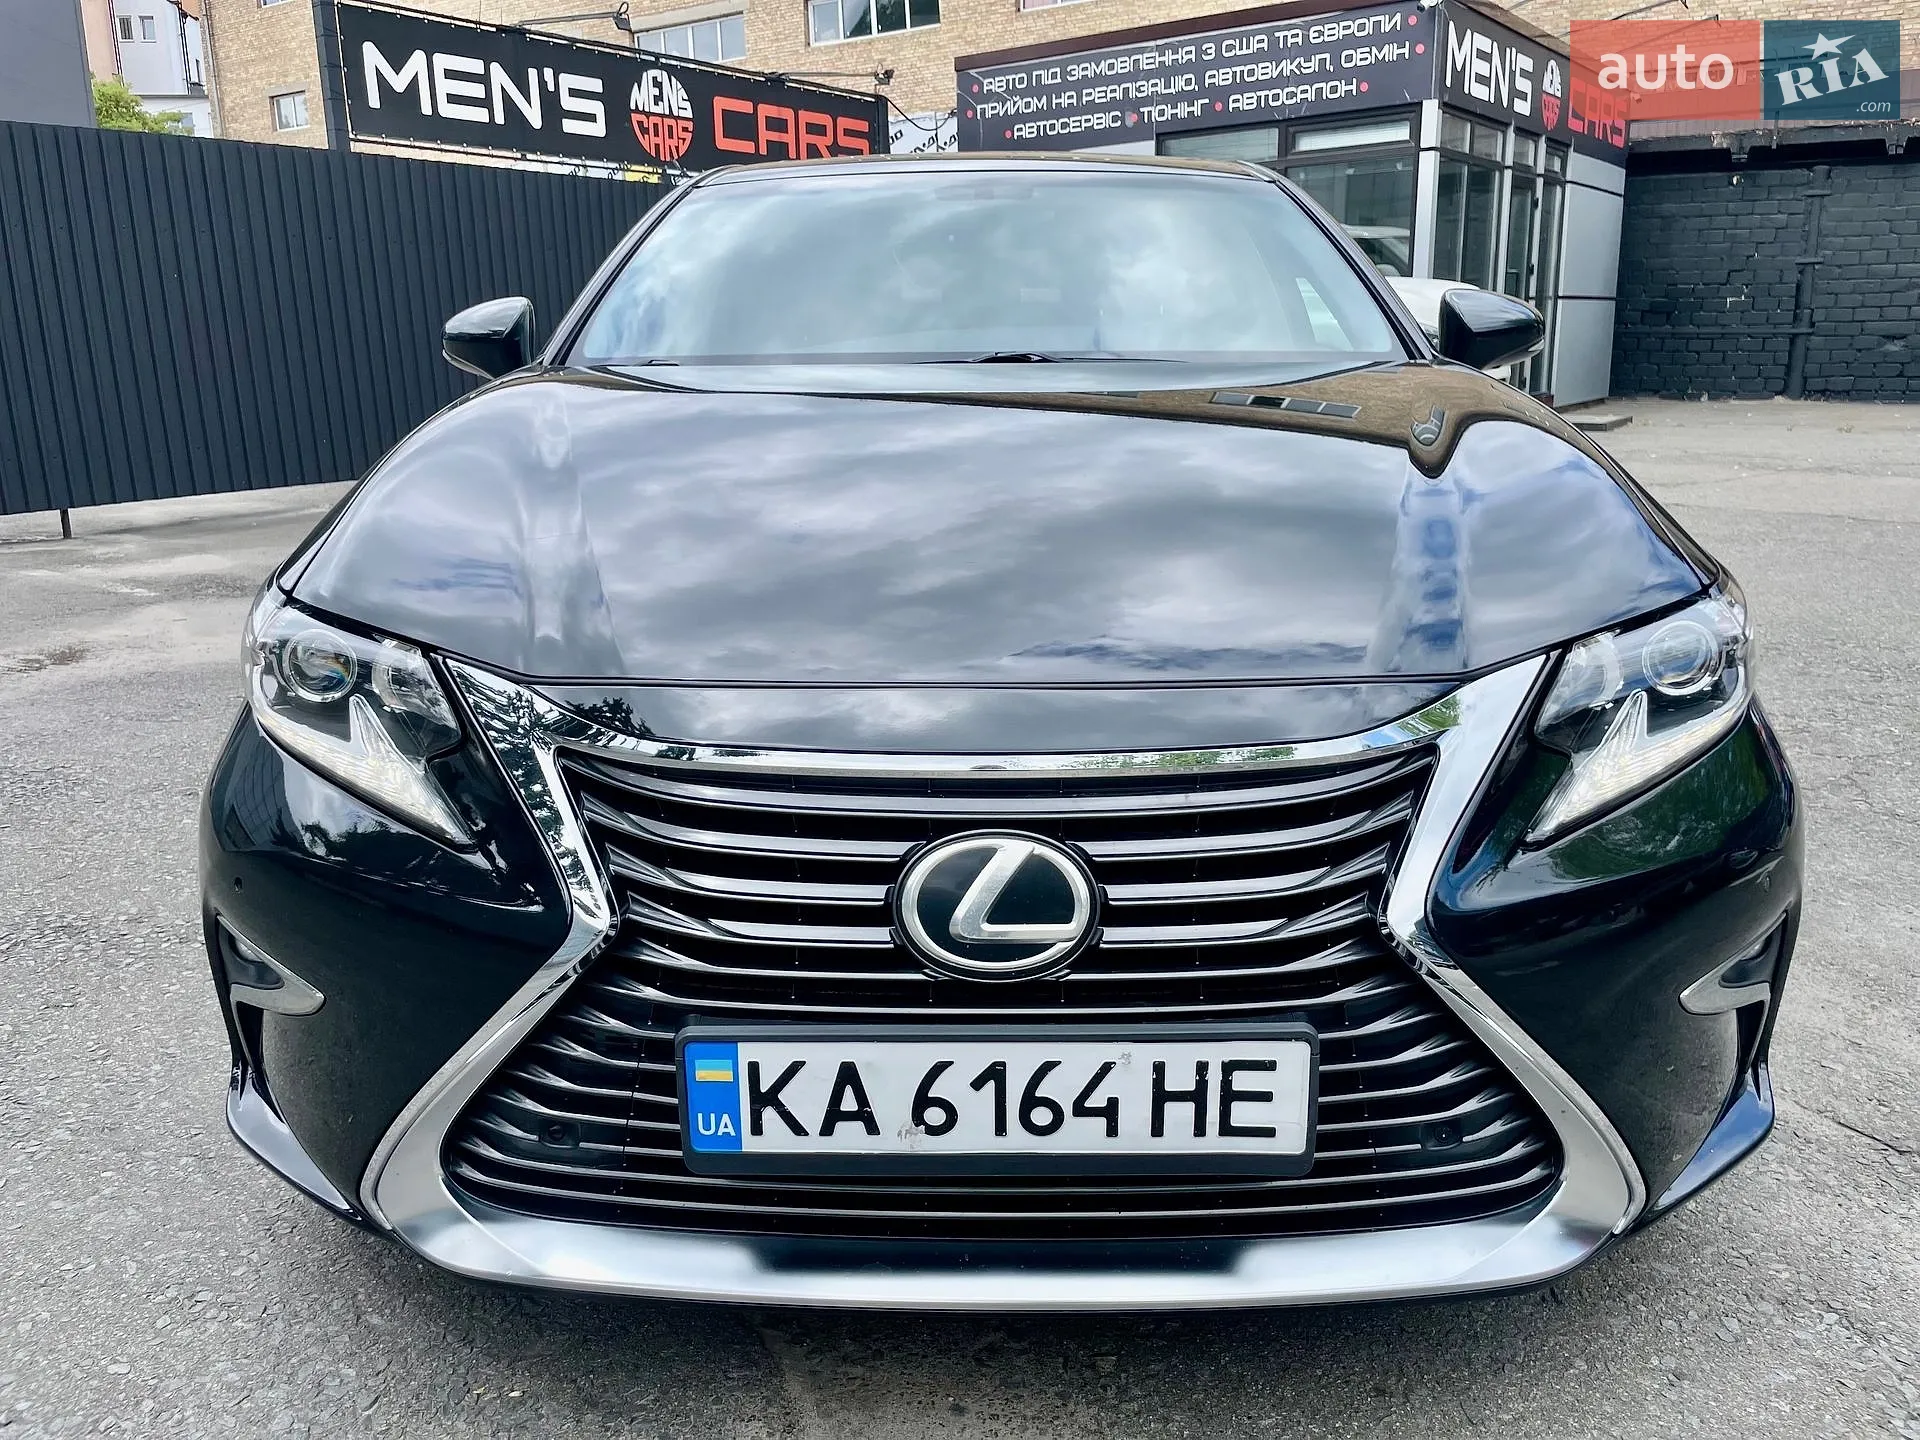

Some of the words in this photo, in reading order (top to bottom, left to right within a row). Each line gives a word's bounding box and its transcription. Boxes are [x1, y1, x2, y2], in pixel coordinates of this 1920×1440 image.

[361, 40, 606, 138] MEN'S
[976, 94, 1047, 120] ПРИЙОМ
[1052, 92, 1082, 110] НА
[1082, 74, 1199, 106] РЕАЛІЗАЦІЮ,
[1204, 53, 1334, 89] АВТОВИКУП,
[1340, 40, 1410, 69] ОБМІН
[983, 73, 1028, 95] АВТО
[1032, 67, 1062, 86] ПІД
[1066, 45, 1196, 82] ЗАМОВЛЕННЯ
[1201, 43, 1216, 61] З
[1221, 34, 1268, 58] США
[1274, 28, 1303, 49] ТА
[1309, 12, 1402, 44] ЄВРОПИ
[1445, 20, 1534, 117] MEN'S
[630, 112, 694, 162] CARS
[713, 96, 871, 159] CARS
[1013, 111, 1122, 141] АВТОСЕРВІС
[1139, 98, 1210, 124] ТЮНІНГ
[1228, 77, 1357, 113] АВТОСАЛОН
[697, 1112, 736, 1138] UA
[746, 1059, 881, 1138] KA
[910, 1059, 1120, 1138] 6164
[1150, 1059, 1278, 1138] HE
